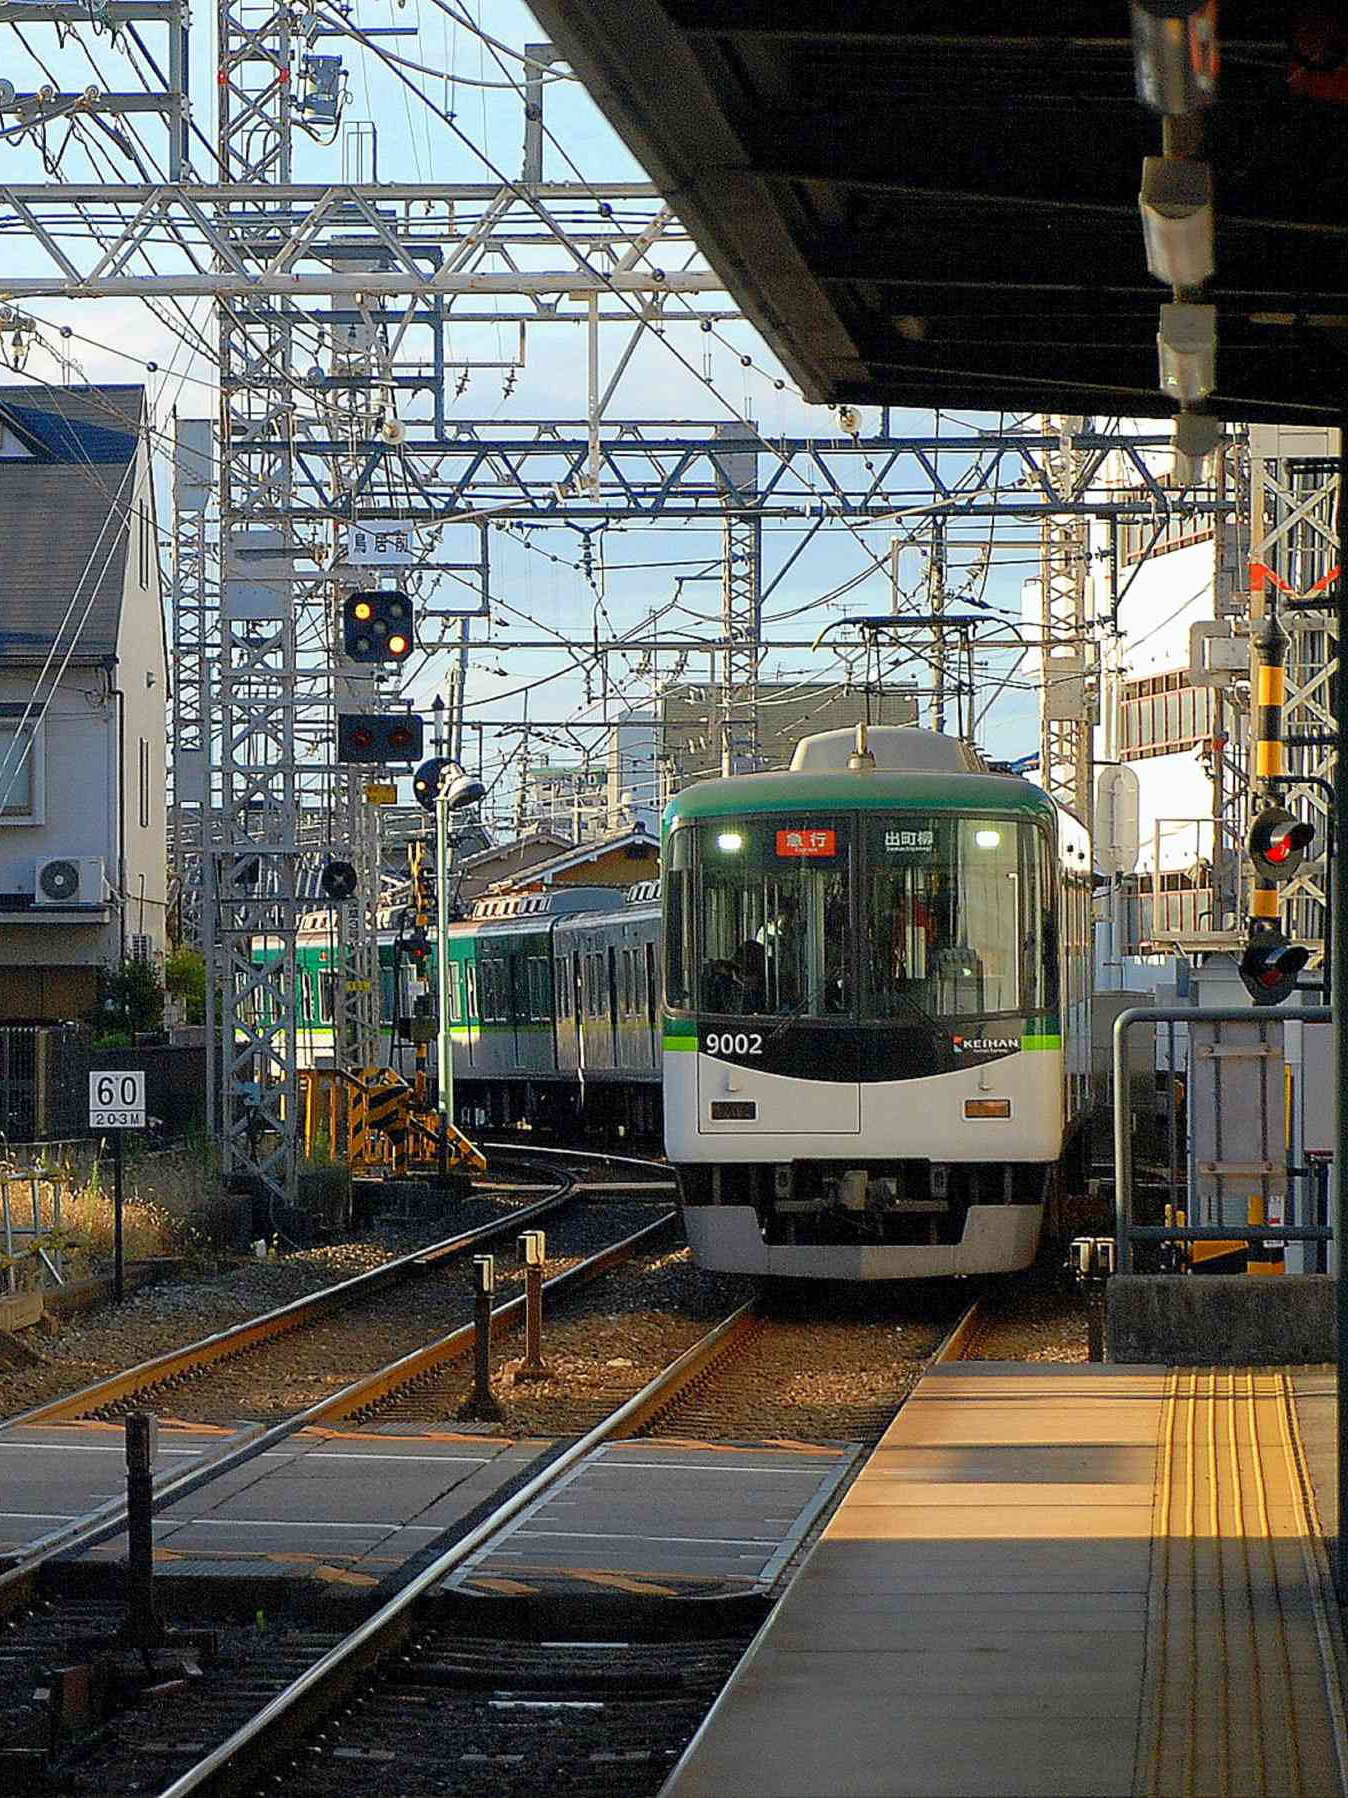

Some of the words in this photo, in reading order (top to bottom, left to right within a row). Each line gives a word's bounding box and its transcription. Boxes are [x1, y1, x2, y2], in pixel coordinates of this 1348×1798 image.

[786, 832, 828, 848] 急行
[885, 831, 933, 846] 出町柳
[706, 1033, 762, 1054] 9002
[963, 1038, 1019, 1049] KEIHAN
[98, 1076, 137, 1106] 60
[96, 1112, 140, 1125] 203M
